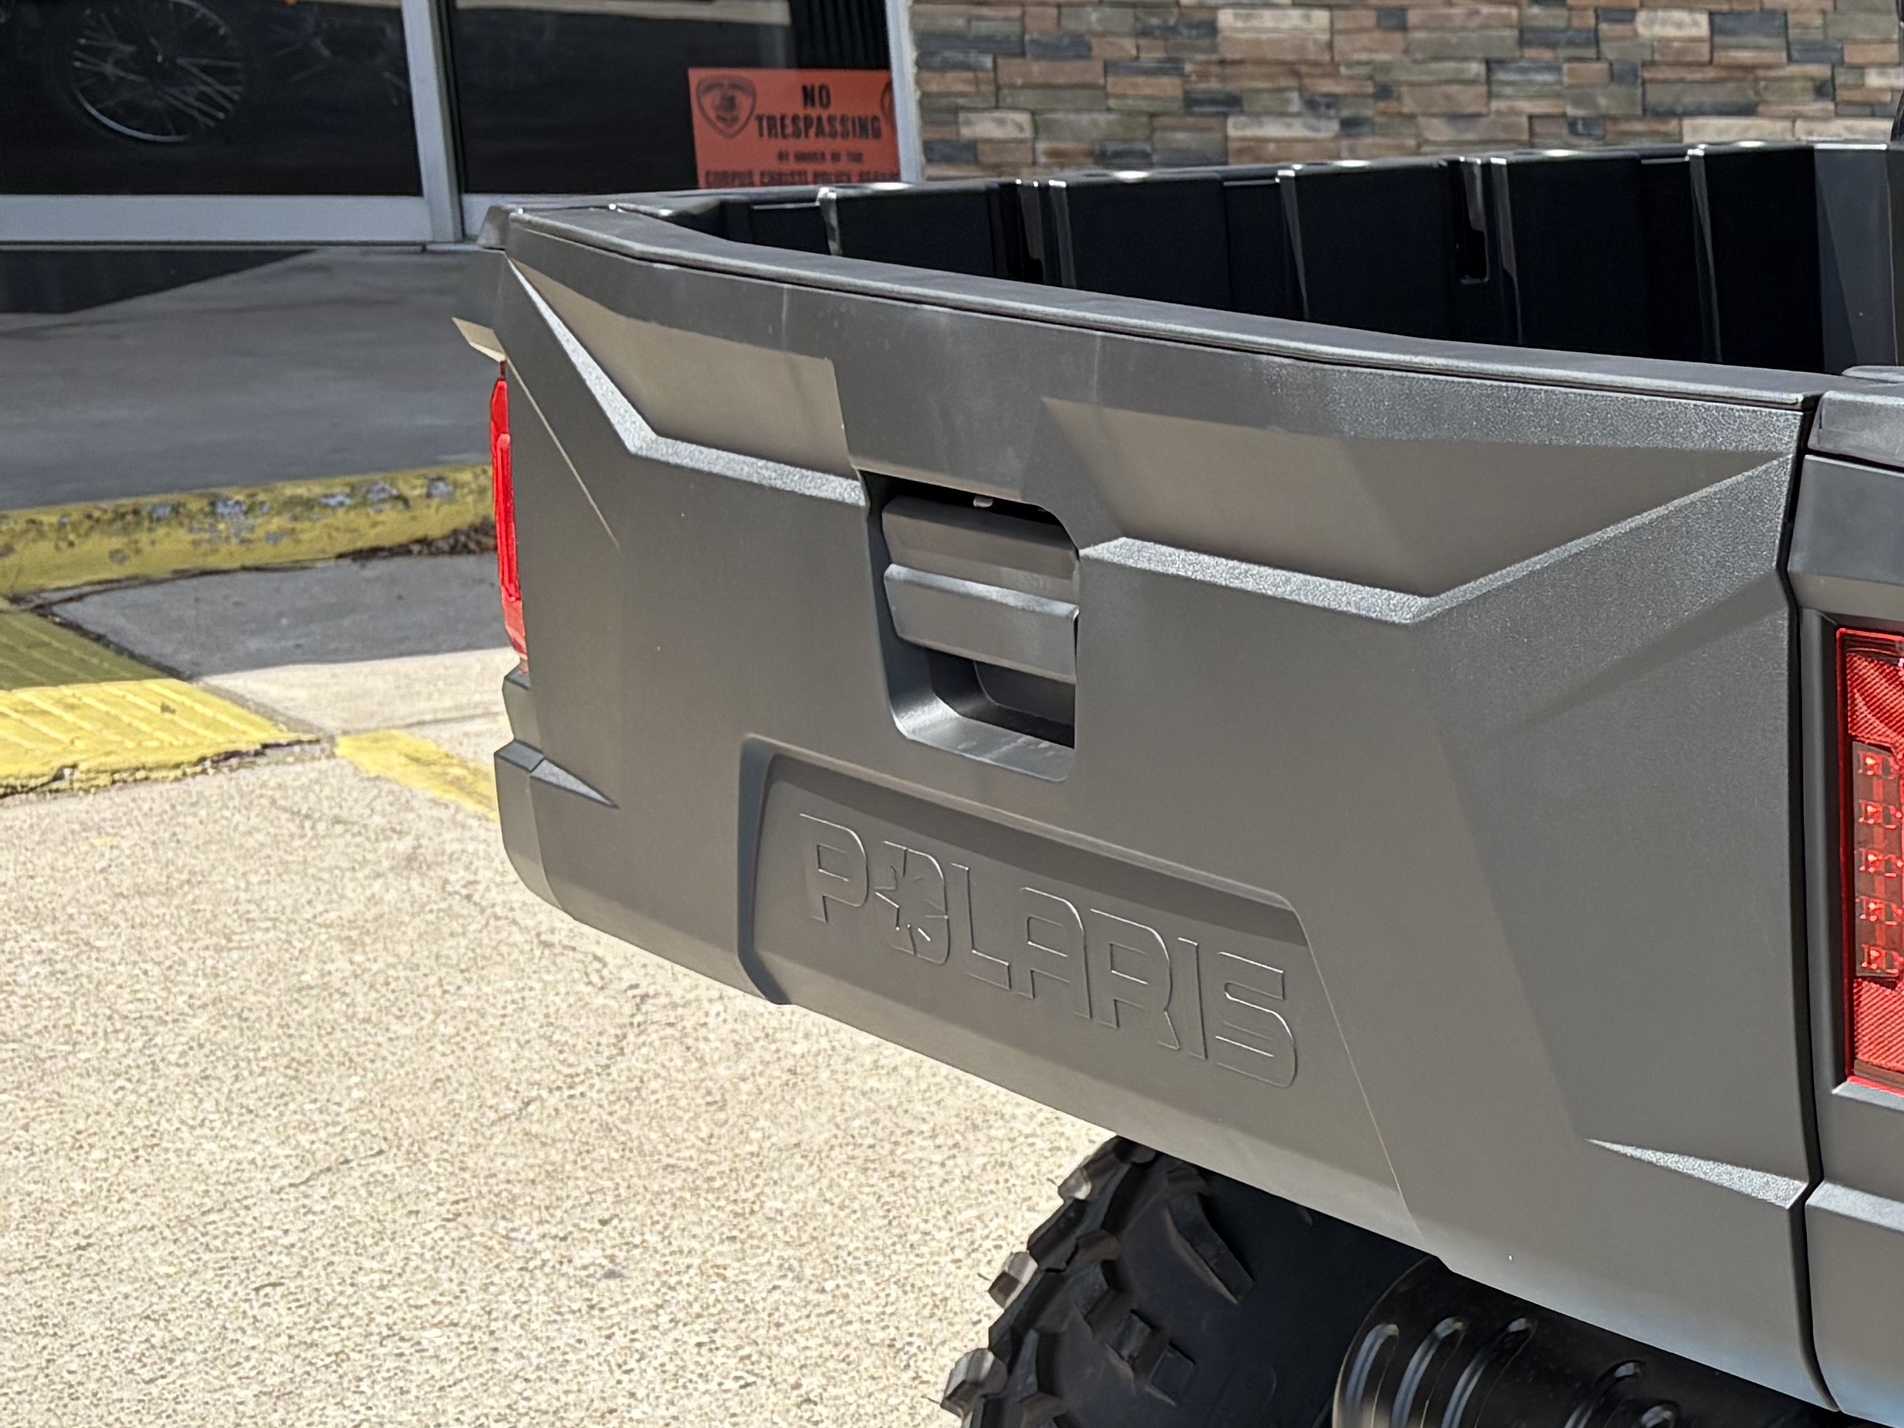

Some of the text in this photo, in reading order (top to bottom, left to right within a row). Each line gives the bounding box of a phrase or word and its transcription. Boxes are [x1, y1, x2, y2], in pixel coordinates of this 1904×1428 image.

[801, 83, 832, 110] NO
[755, 114, 882, 140] TRESPASSING
[800, 813, 1298, 1089] POLARIS
